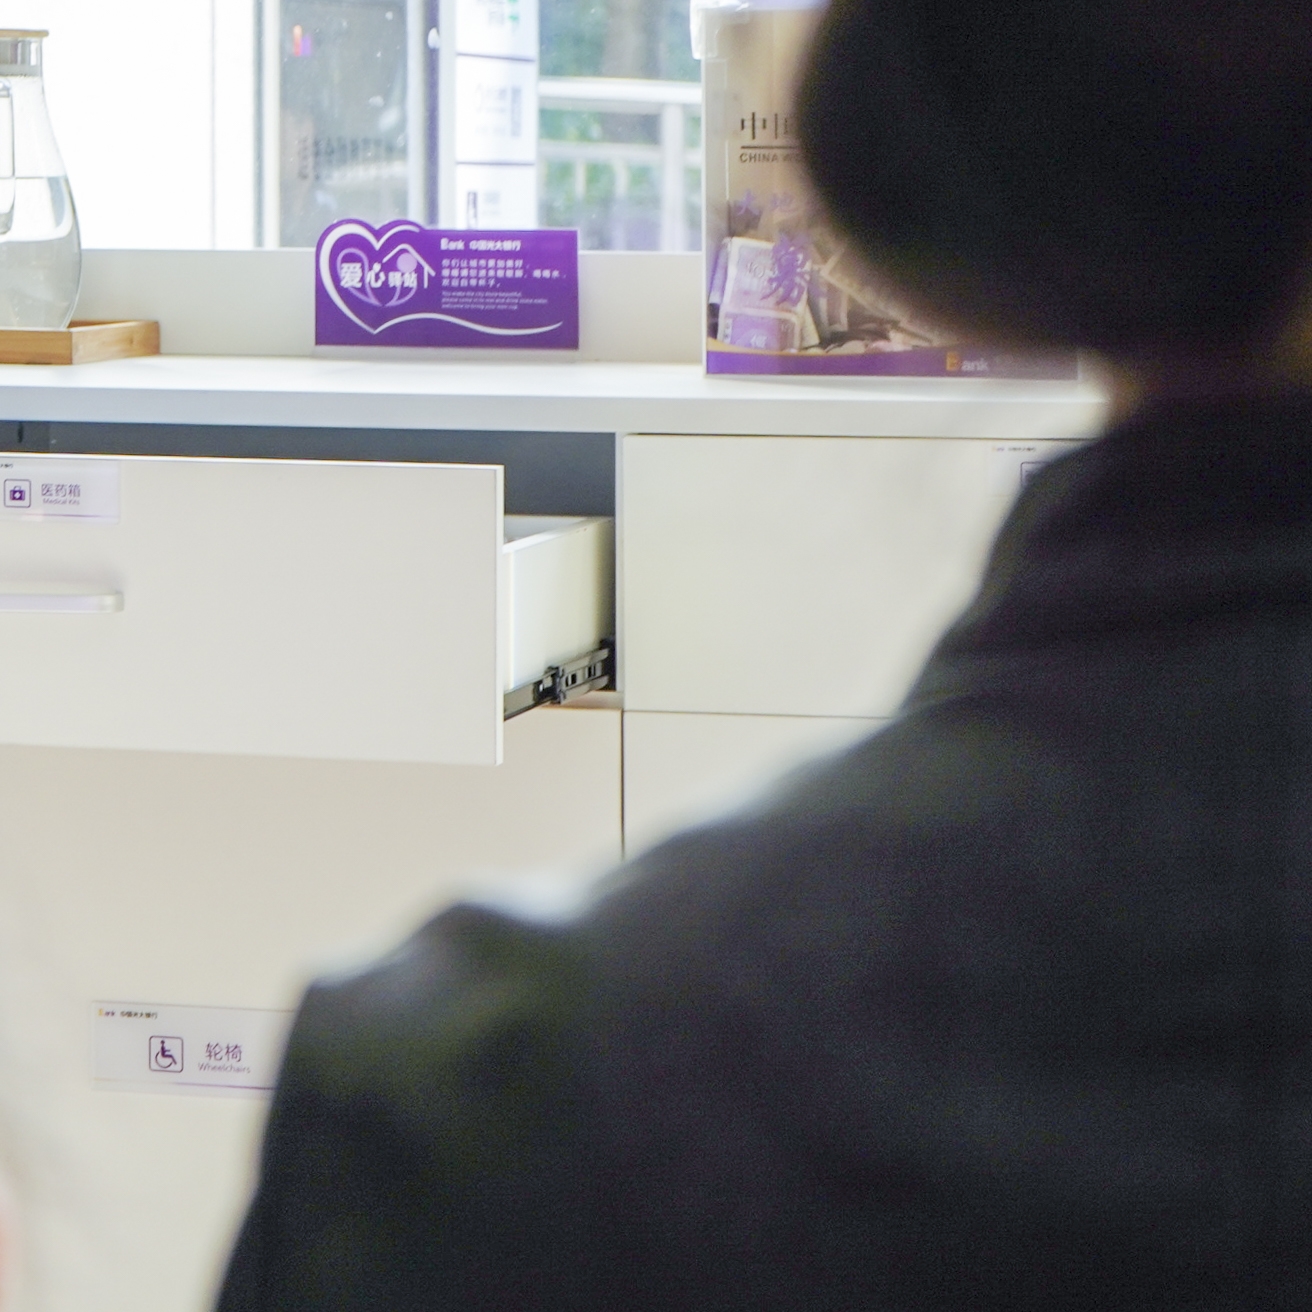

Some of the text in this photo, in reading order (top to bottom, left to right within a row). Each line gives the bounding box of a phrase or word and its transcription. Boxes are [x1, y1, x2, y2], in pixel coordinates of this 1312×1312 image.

[739, 152, 779, 163] CHINA
[41, 483, 81, 498] 医药箱
[205, 1042, 242, 1063] 轮椅
[198, 1062, 251, 1075] Wheelchairs
